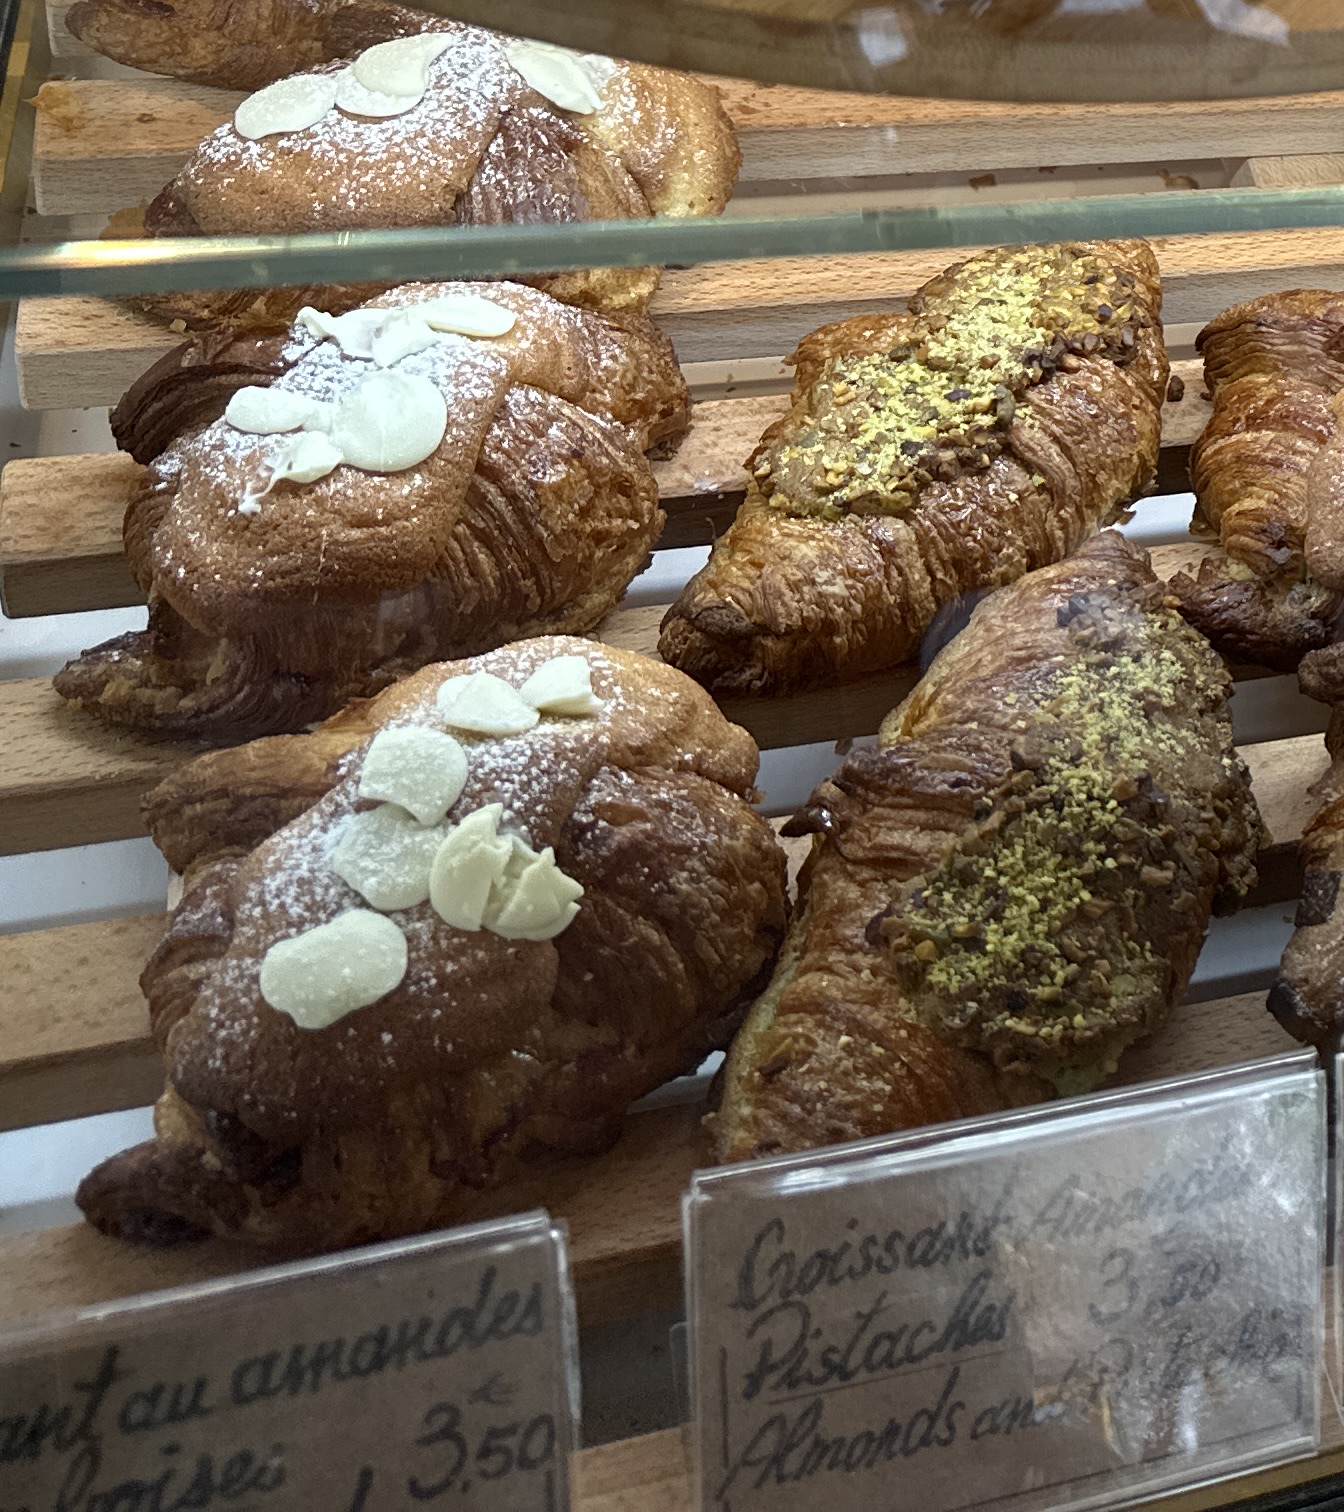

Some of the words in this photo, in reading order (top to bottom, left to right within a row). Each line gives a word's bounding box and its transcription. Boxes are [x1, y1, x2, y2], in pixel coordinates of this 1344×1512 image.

[731, 1156, 1021, 1311] Croissant
[116, 1376, 208, 1434] au
[229, 1265, 546, 1406] amandes
[720, 1366, 966, 1492] Almonds
